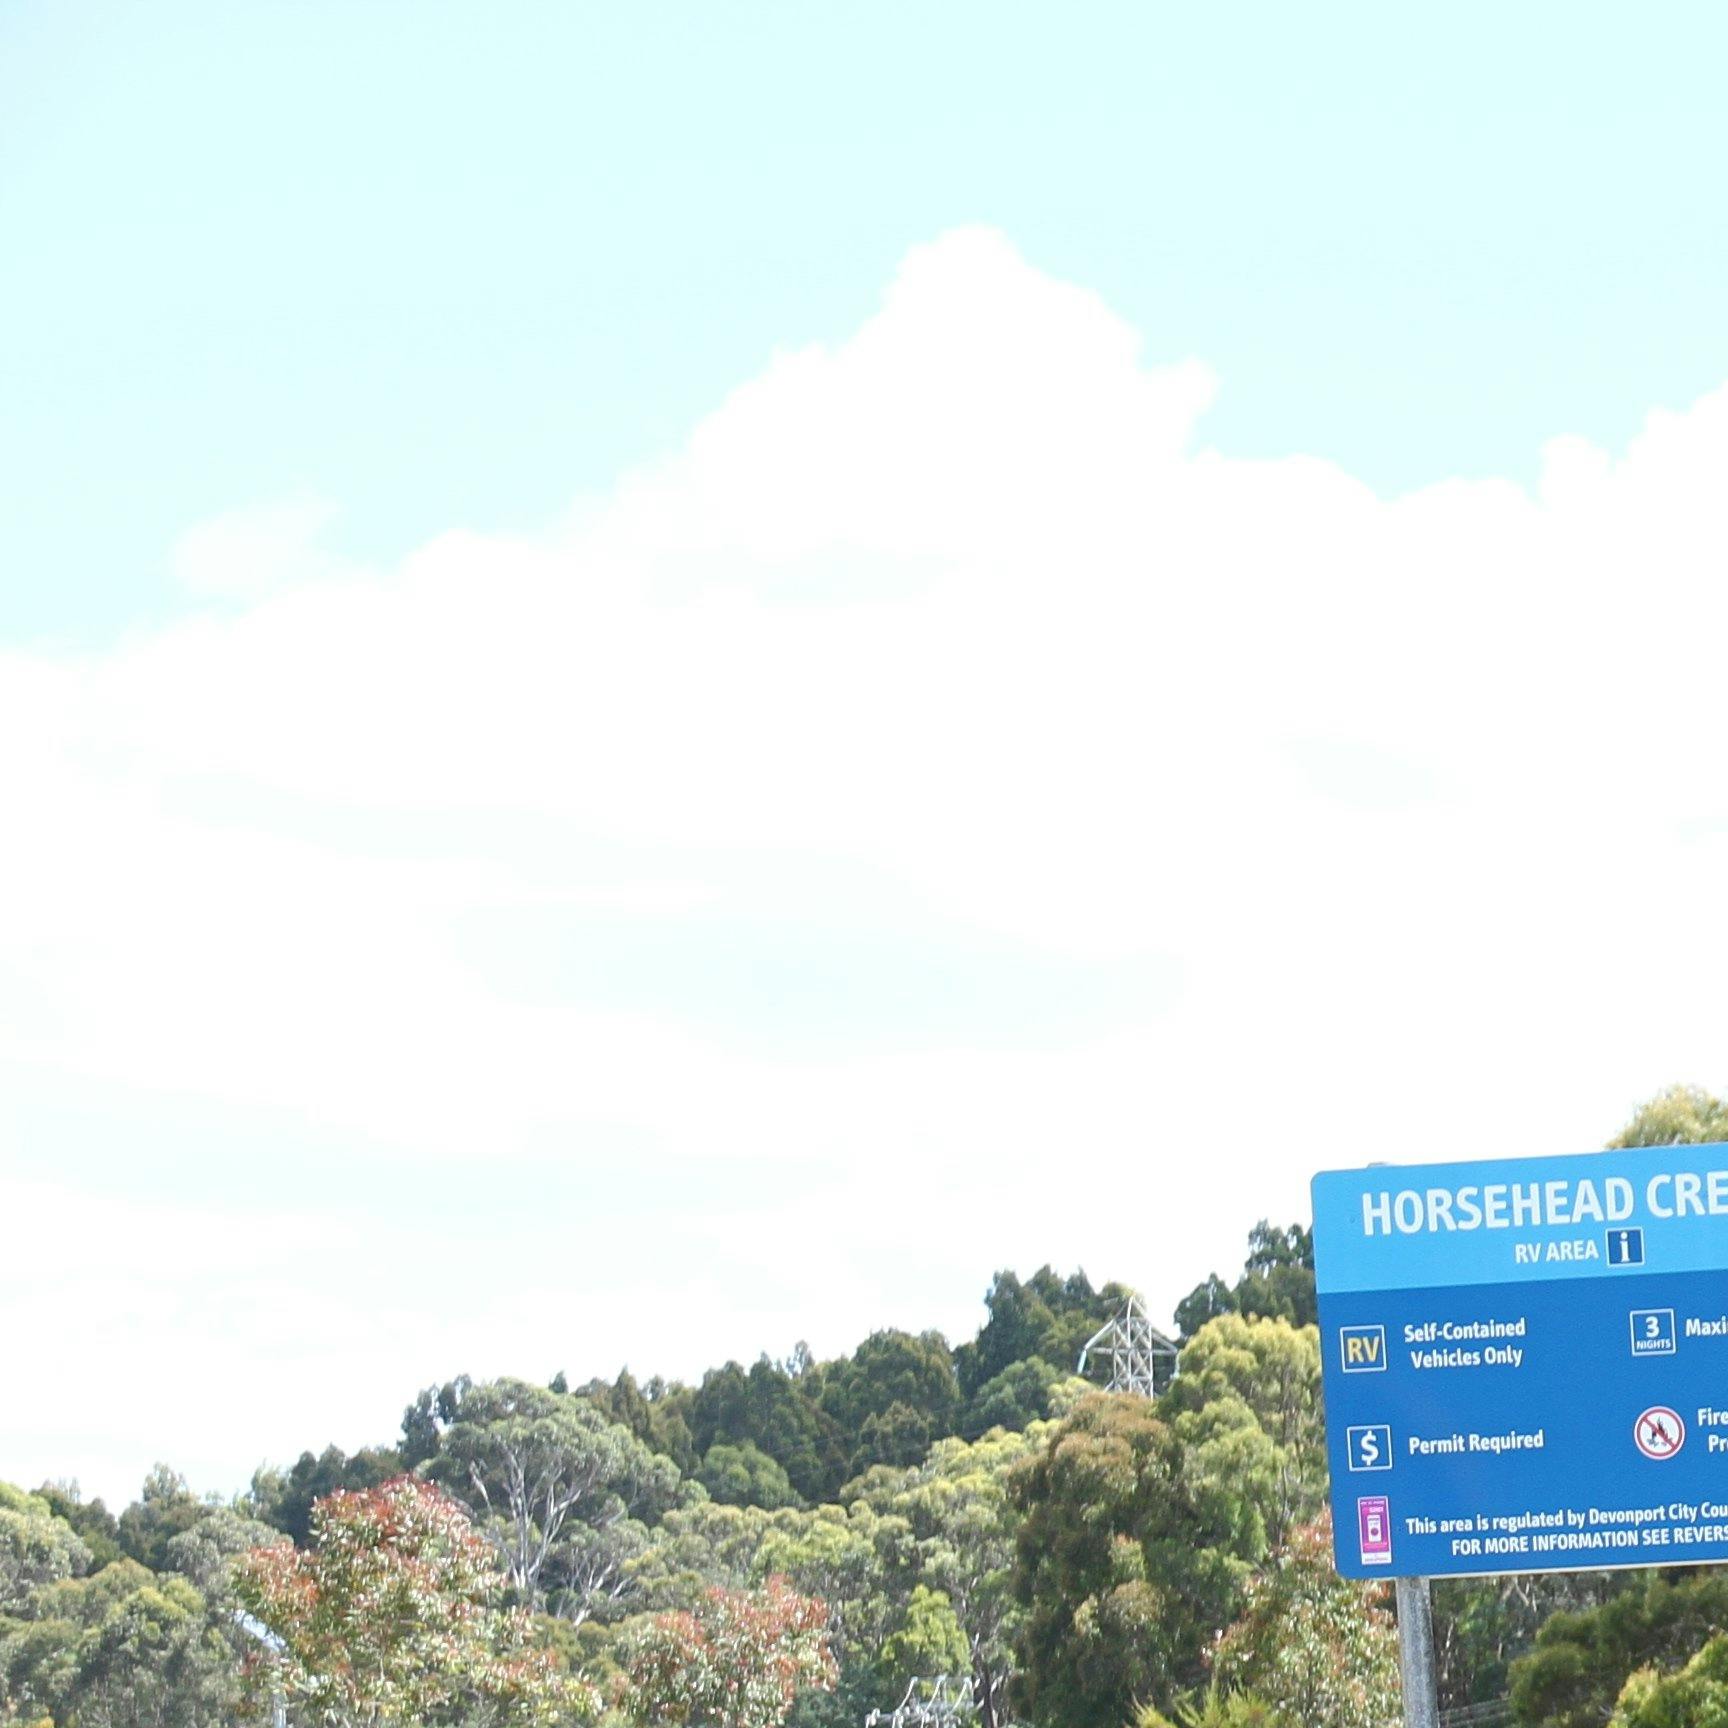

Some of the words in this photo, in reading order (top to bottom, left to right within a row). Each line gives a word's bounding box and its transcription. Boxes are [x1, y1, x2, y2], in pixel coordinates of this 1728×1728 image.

[1362, 1177, 1635, 1235] HORSEHEAD
[1515, 1243, 1541, 1264] RV
[1545, 1239, 1600, 1262] AREA
[1404, 1317, 1526, 1343] Self-Contained
[1645, 1316, 1660, 1338] 3
[1346, 1336, 1380, 1363] RV
[1410, 1347, 1481, 1369] Vehicles
[1484, 1344, 1523, 1368] Only
[1636, 1338, 1671, 1350] NIGHTS
[1409, 1434, 1465, 1455] Permit
[1469, 1428, 1544, 1454] Required
[1405, 1517, 1437, 1535] This
[1440, 1519, 1473, 1533] area
[1476, 1513, 1489, 1531] is
[1493, 1508, 1564, 1533] regulated
[1567, 1508, 1586, 1529] by
[1589, 1505, 1666, 1527] Devonport
[1668, 1503, 1698, 1523] City
[1452, 1538, 1481, 1556] FOR
[1485, 1535, 1529, 1555] MORE
[1533, 1529, 1639, 1551] INFORMATION
[1642, 1528, 1670, 1546] SEE
